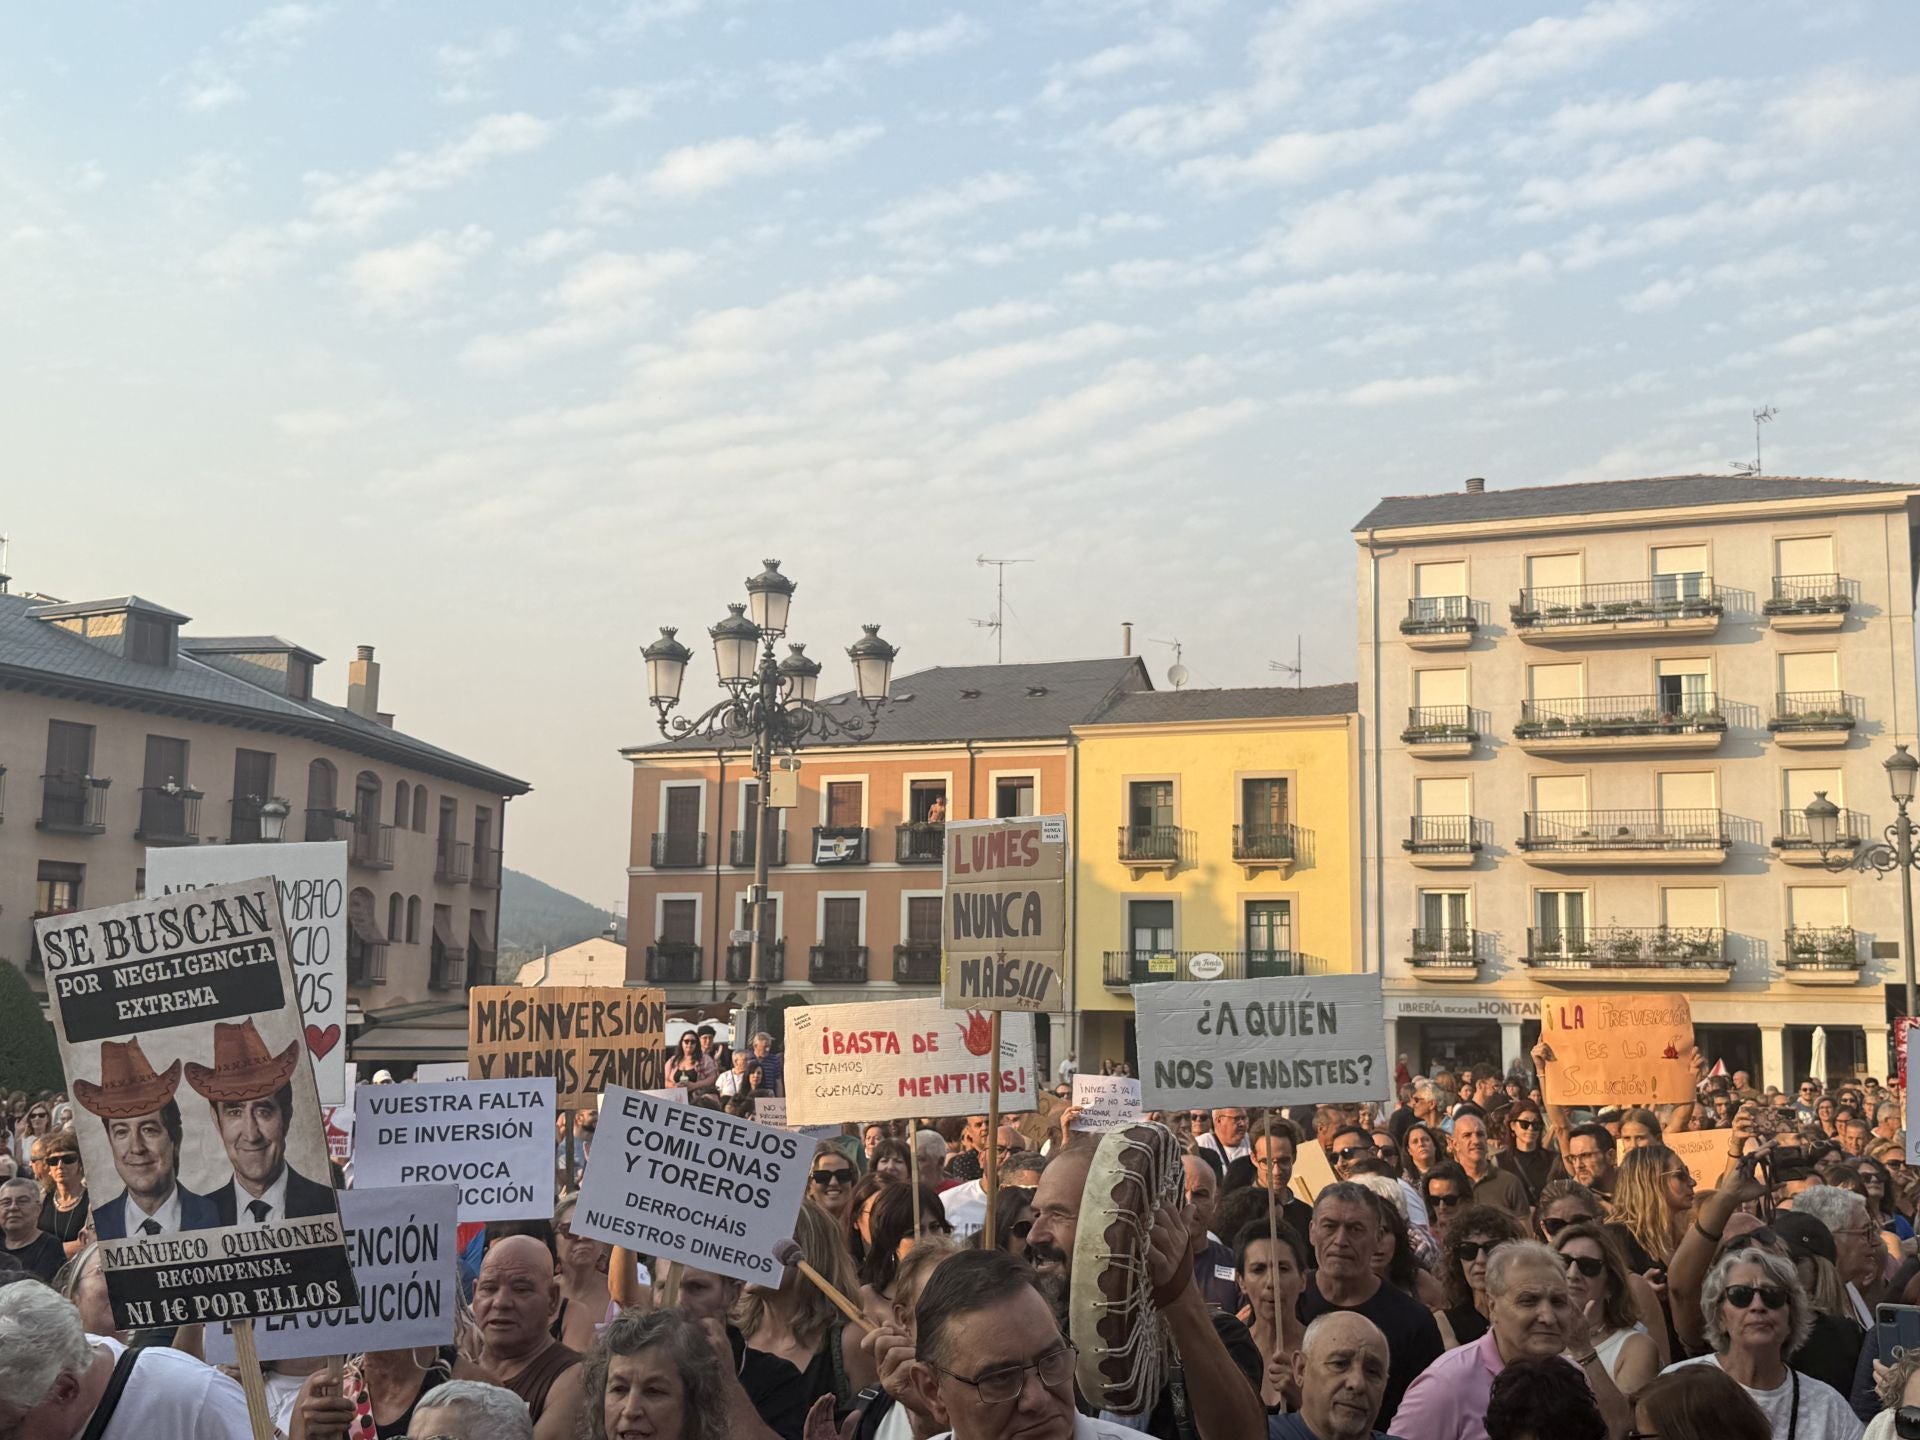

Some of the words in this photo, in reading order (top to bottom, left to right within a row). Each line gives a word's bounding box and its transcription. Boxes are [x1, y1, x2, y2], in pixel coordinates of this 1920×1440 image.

[954, 829, 1040, 874] LUMES
[277, 879, 342, 921] MBAO
[953, 890, 1042, 940] NUNCA
[43, 924, 95, 971] SE
[98, 891, 272, 961] BUSCAN
[289, 925, 330, 966] CIO
[58, 974, 102, 998] POR
[112, 942, 275, 989] NEGLIGENCIA
[116, 986, 219, 1020] EXTREMA
[296, 973, 333, 1014] OS
[1398, 1000, 1442, 1013] LIBRERÍA
[1245, 991, 1337, 1038] QUIÉN
[822, 1027, 900, 1055] ¡BASTA
[913, 1031, 939, 1054] DE
[477, 1053, 497, 1080] Y
[504, 1049, 579, 1094] MENOS
[806, 1061, 863, 1075] ESTAMOS
[1111, 1084, 1117, 1093] 3
[1154, 1059, 1214, 1089] NOS
[1225, 1054, 1373, 1089] VENDISTEIS?
[370, 1094, 473, 1115] VUESTRA
[479, 1091, 544, 1110] FALTA
[815, 1083, 884, 1098] QUEMADOS
[1081, 1097, 1091, 1105] EL
[1094, 1097, 1105, 1105] PP
[378, 1128, 408, 1145] DE
[415, 1118, 533, 1144] INVERSIÓN
[622, 1096, 659, 1123] EN
[664, 1107, 798, 1160] FESTEJOS
[401, 1161, 511, 1183] PROVOCA
[626, 1126, 781, 1183] COMILONAS
[624, 1152, 641, 1173] Y
[647, 1158, 772, 1209] TOREROS
[625, 1192, 747, 1238] DERROCHÁIS
[105, 1238, 208, 1268] MAÑUECO
[221, 1221, 339, 1258] QUIÑONES
[585, 1210, 687, 1250] NUESTROS
[690, 1238, 774, 1273] DINEROS
[156, 1257, 293, 1289] RECOMPENSA:
[125, 1301, 153, 1326] NI
[161, 1298, 189, 1323] 1€
[193, 1291, 250, 1320] POR
[253, 1280, 341, 1313] ELLOS
